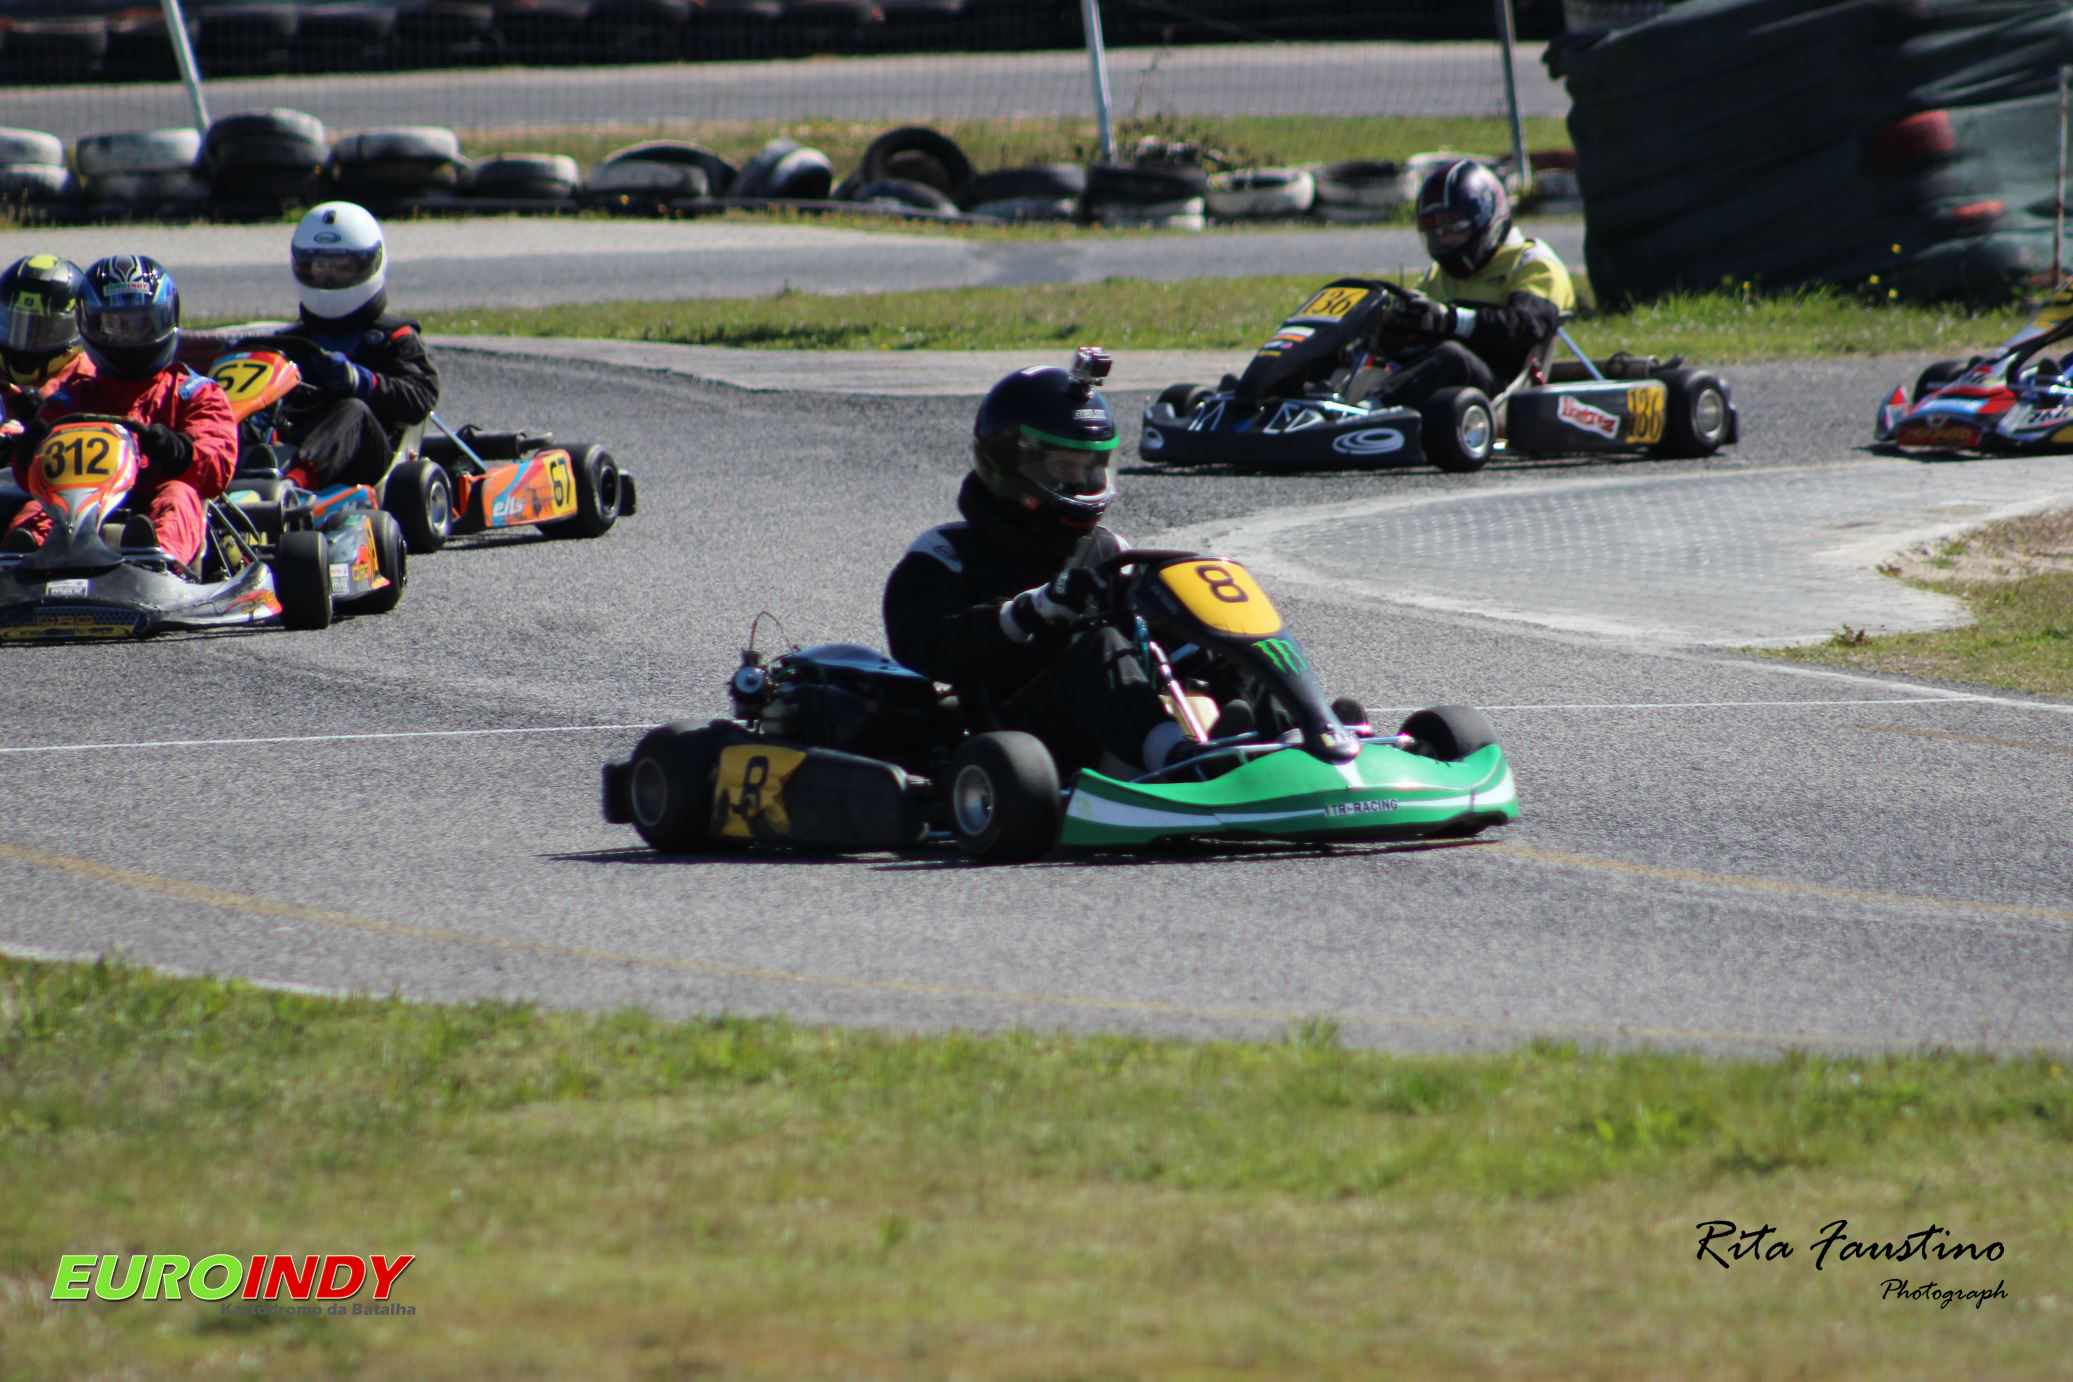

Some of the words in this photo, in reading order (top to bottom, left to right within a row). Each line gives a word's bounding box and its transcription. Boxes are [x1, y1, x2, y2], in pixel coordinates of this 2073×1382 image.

[1300, 288, 1354, 315] 136
[1629, 388, 1660, 440] 136
[43, 437, 110, 478] 312
[549, 456, 571, 508] 67
[1196, 565, 1249, 604] 8
